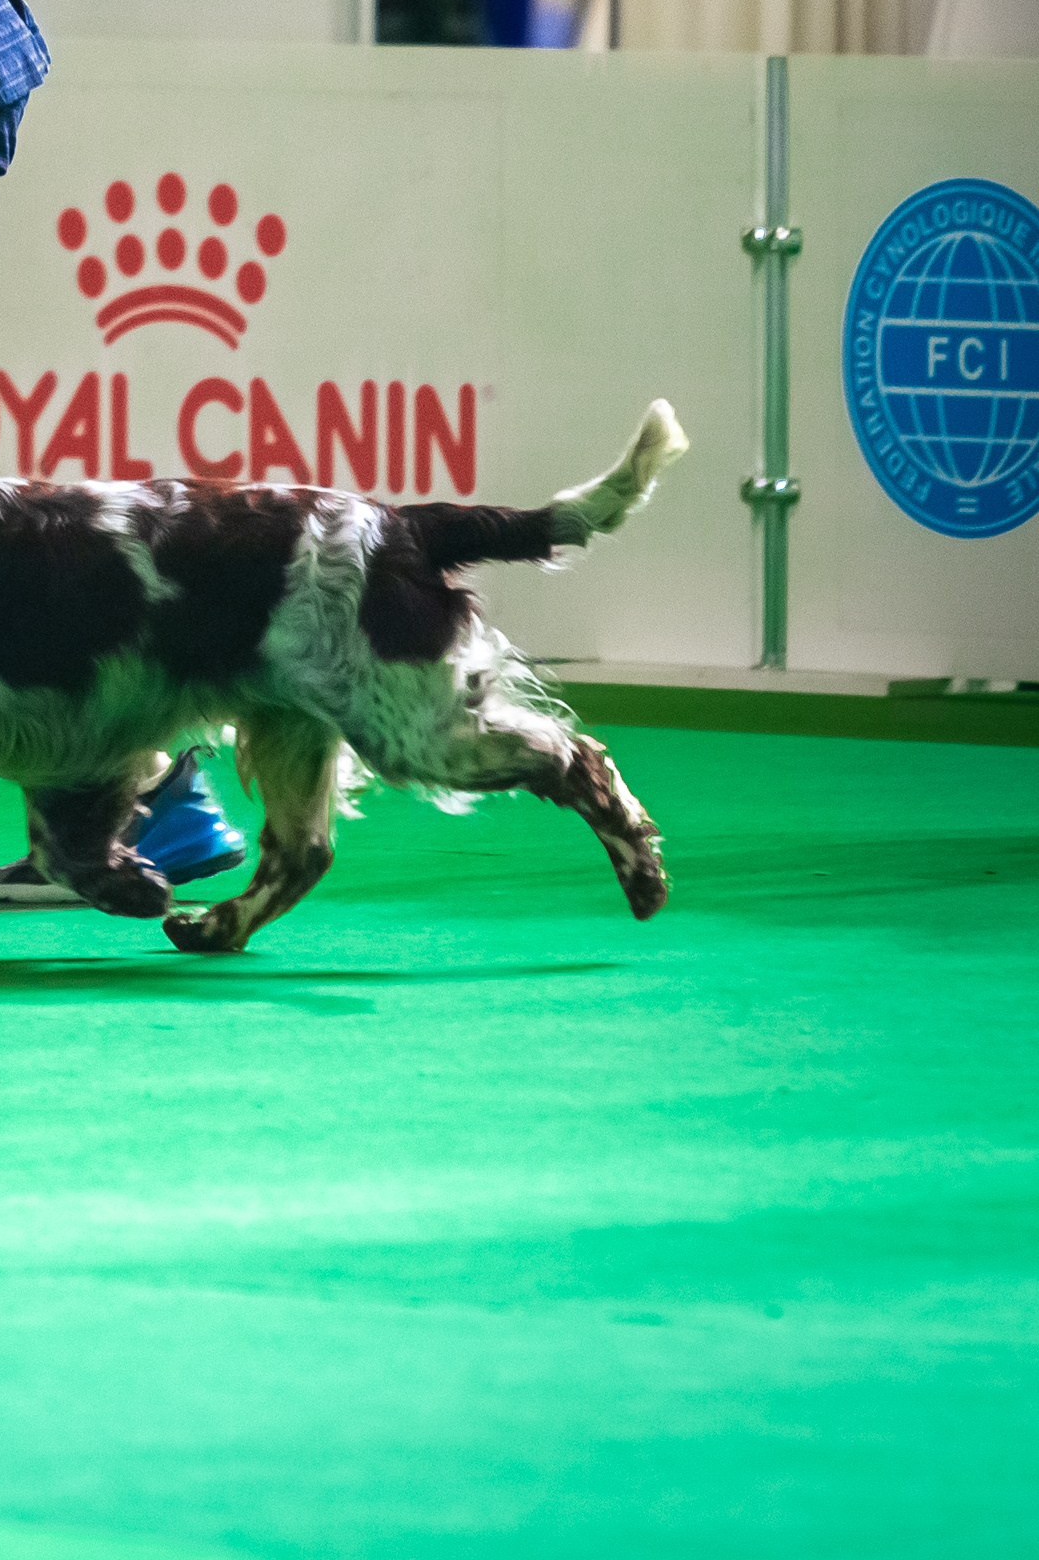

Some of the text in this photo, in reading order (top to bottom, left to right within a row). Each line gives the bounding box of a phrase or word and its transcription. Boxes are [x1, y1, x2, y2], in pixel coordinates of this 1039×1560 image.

[864, 200, 1031, 300] CYNOLOGIQUE
[928, 336, 1007, 382] FCI
[177, 376, 476, 496] CANIN
